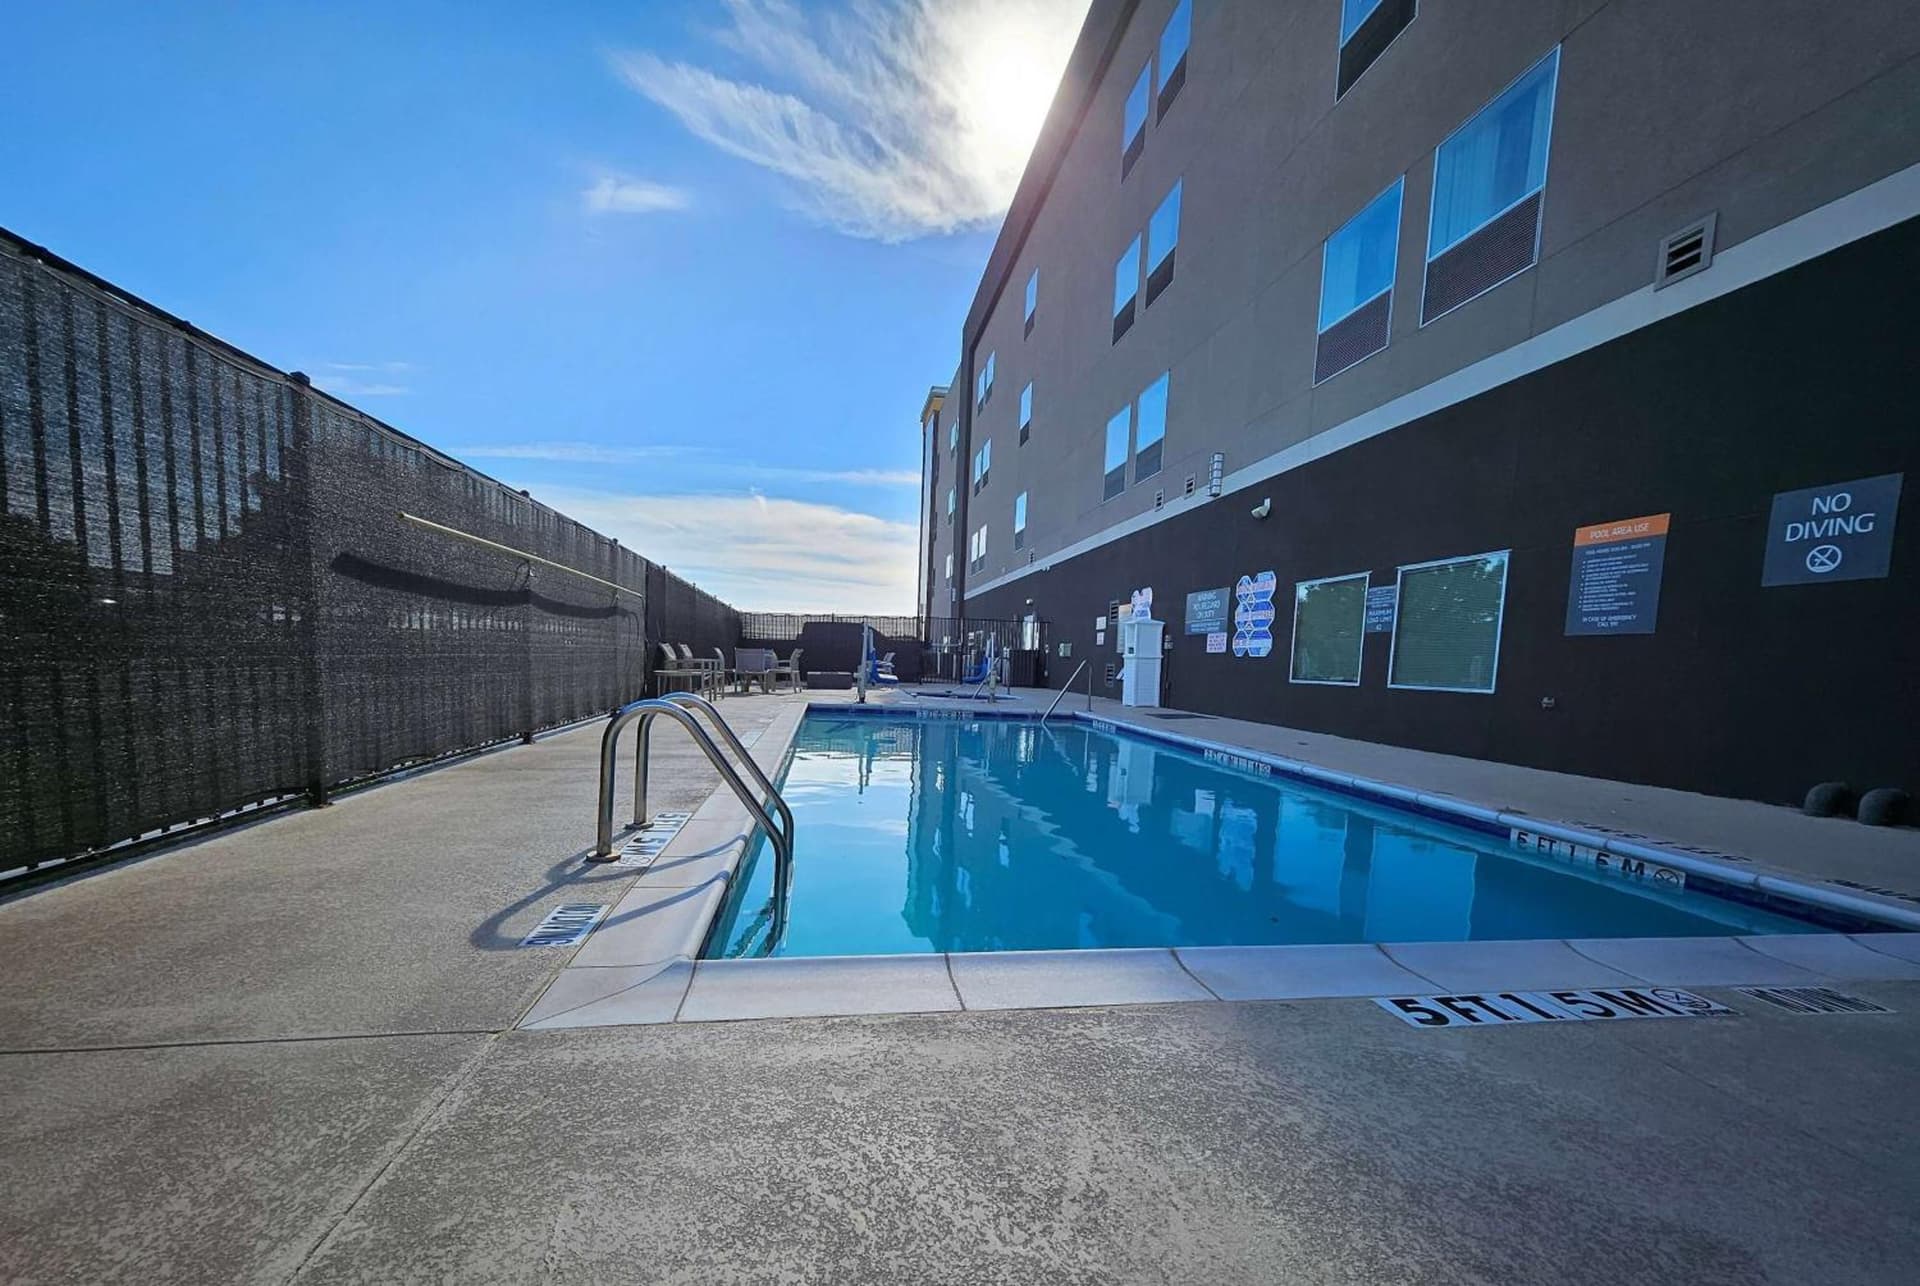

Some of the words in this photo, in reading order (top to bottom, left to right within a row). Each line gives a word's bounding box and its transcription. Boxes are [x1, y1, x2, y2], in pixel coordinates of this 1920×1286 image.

[1812, 493, 1851, 516] NO
[1590, 530, 1610, 539] POOL
[1611, 525, 1633, 536] AREA
[1634, 522, 1649, 532] USE
[1785, 513, 1875, 542] DIVING
